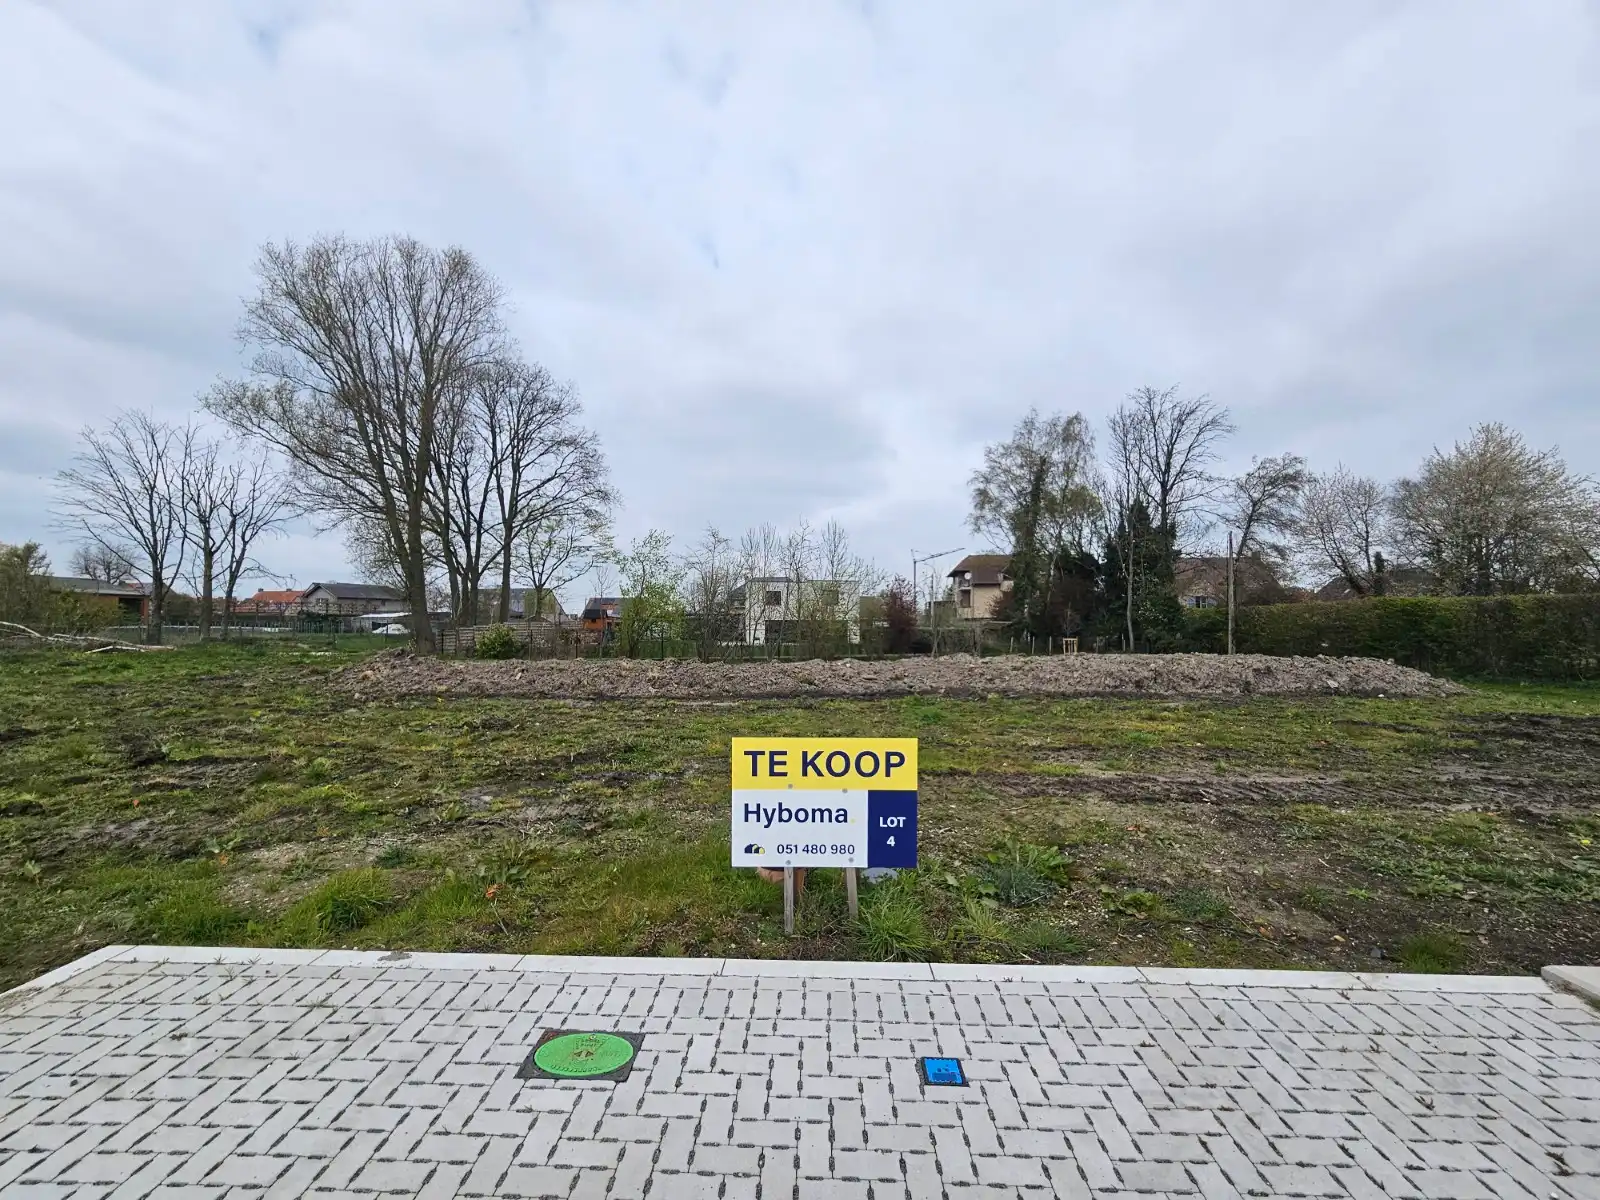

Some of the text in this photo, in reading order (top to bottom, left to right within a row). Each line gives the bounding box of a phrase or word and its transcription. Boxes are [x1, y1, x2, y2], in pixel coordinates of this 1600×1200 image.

[744, 750, 906, 778] TE KOOP
[879, 816, 907, 828] LOT
[886, 835, 896, 847] 4
[776, 843, 856, 855] 051 480 980
